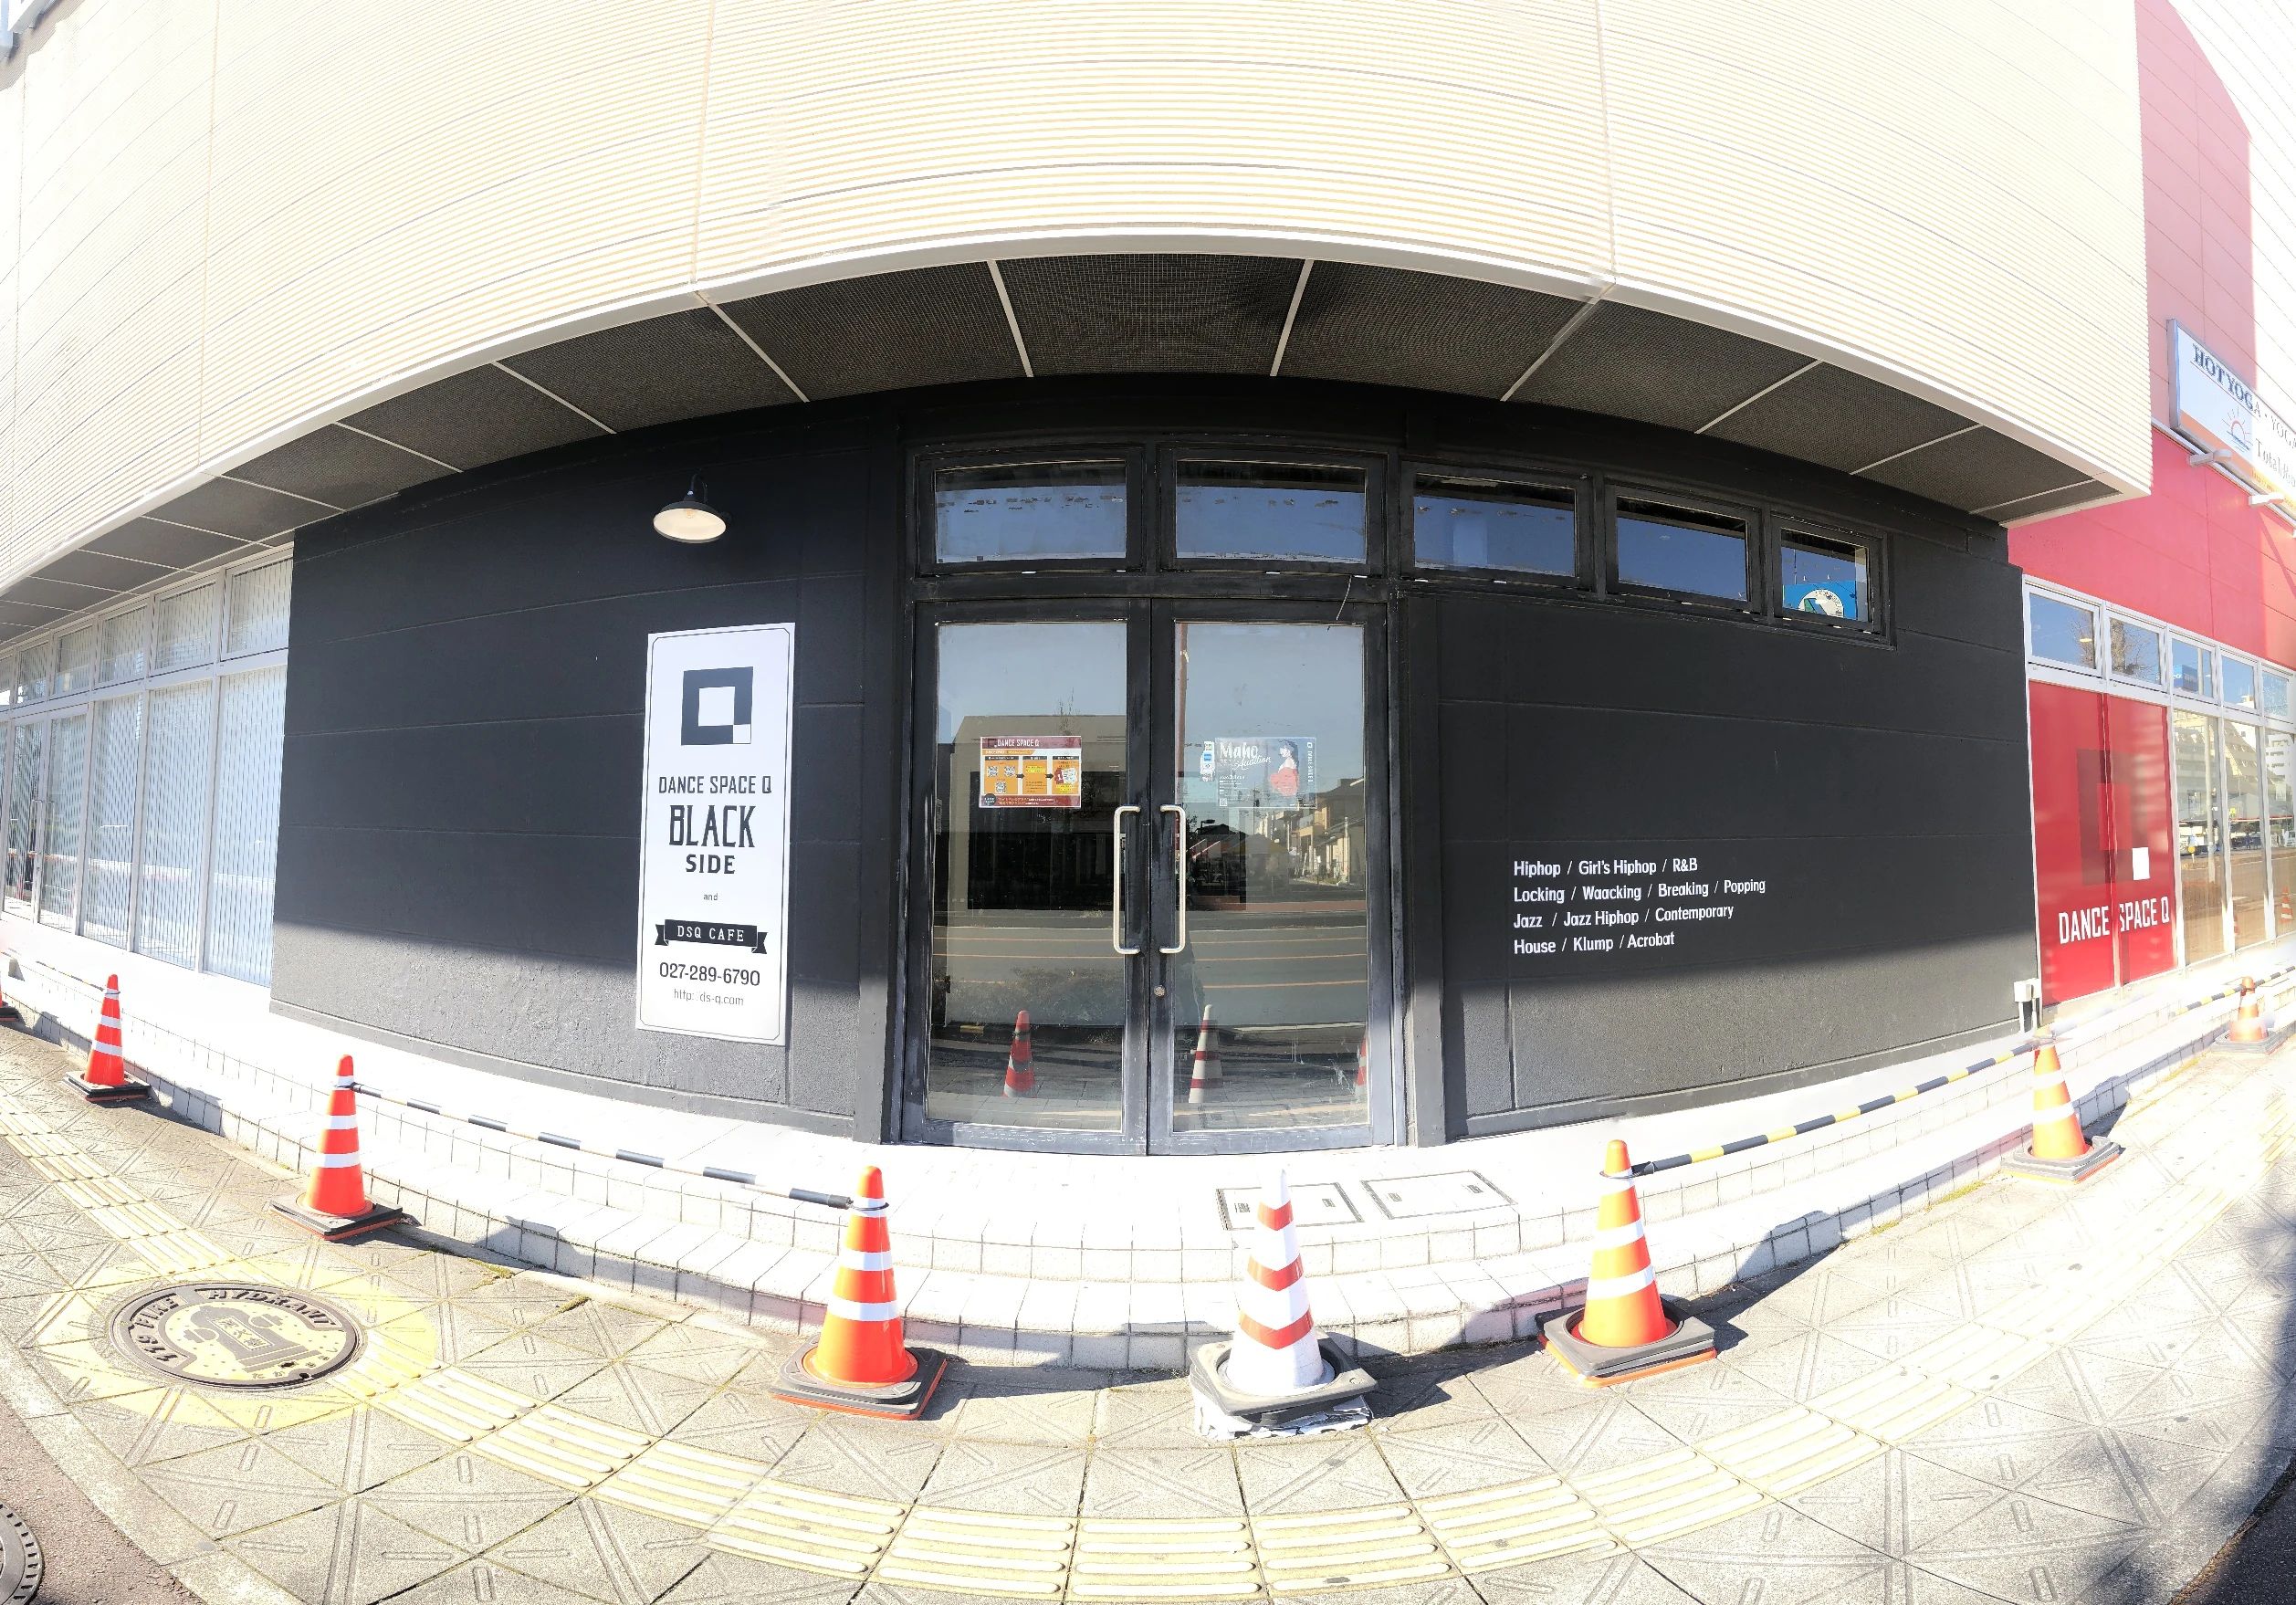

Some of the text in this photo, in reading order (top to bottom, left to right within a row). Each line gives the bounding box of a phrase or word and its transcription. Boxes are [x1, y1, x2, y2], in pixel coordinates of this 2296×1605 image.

[2193, 343, 2261, 418] HOTYOGA
[997, 739, 1015, 747] DANCE
[1016, 739, 1033, 747] SPACE
[658, 775, 772, 794] DANCE SPACE Q
[668, 804, 755, 848] BLACK
[685, 854, 736, 875] SIDE
[1514, 860, 1561, 877] Hiphop
[1578, 859, 1610, 876] Girl's
[1613, 859, 1657, 876] Hiphop
[1672, 857, 1698, 872] R&B
[703, 892, 718, 901] and
[1514, 886, 1565, 904] Locking
[1582, 885, 1642, 901] Waacking
[1658, 882, 1709, 897] Breaking
[1724, 878, 1766, 894] Popping
[1514, 913, 1543, 928] Jazz
[1564, 911, 1592, 927] Jazz
[1595, 910, 1640, 927] Hiphop
[1655, 905, 1734, 922] Contemporary
[2058, 905, 2111, 944] DANCE
[2160, 896, 2170, 924] Q
[676, 924, 745, 942] DSQ CAFE
[1514, 939, 1557, 954] House
[1573, 936, 1614, 952] Klump
[1627, 931, 1675, 949] Acrobat
[659, 961, 760, 986] 027-289-6790
[133, 1296, 180, 1329] FIRE
[208, 1288, 338, 1327] HYDRANT
